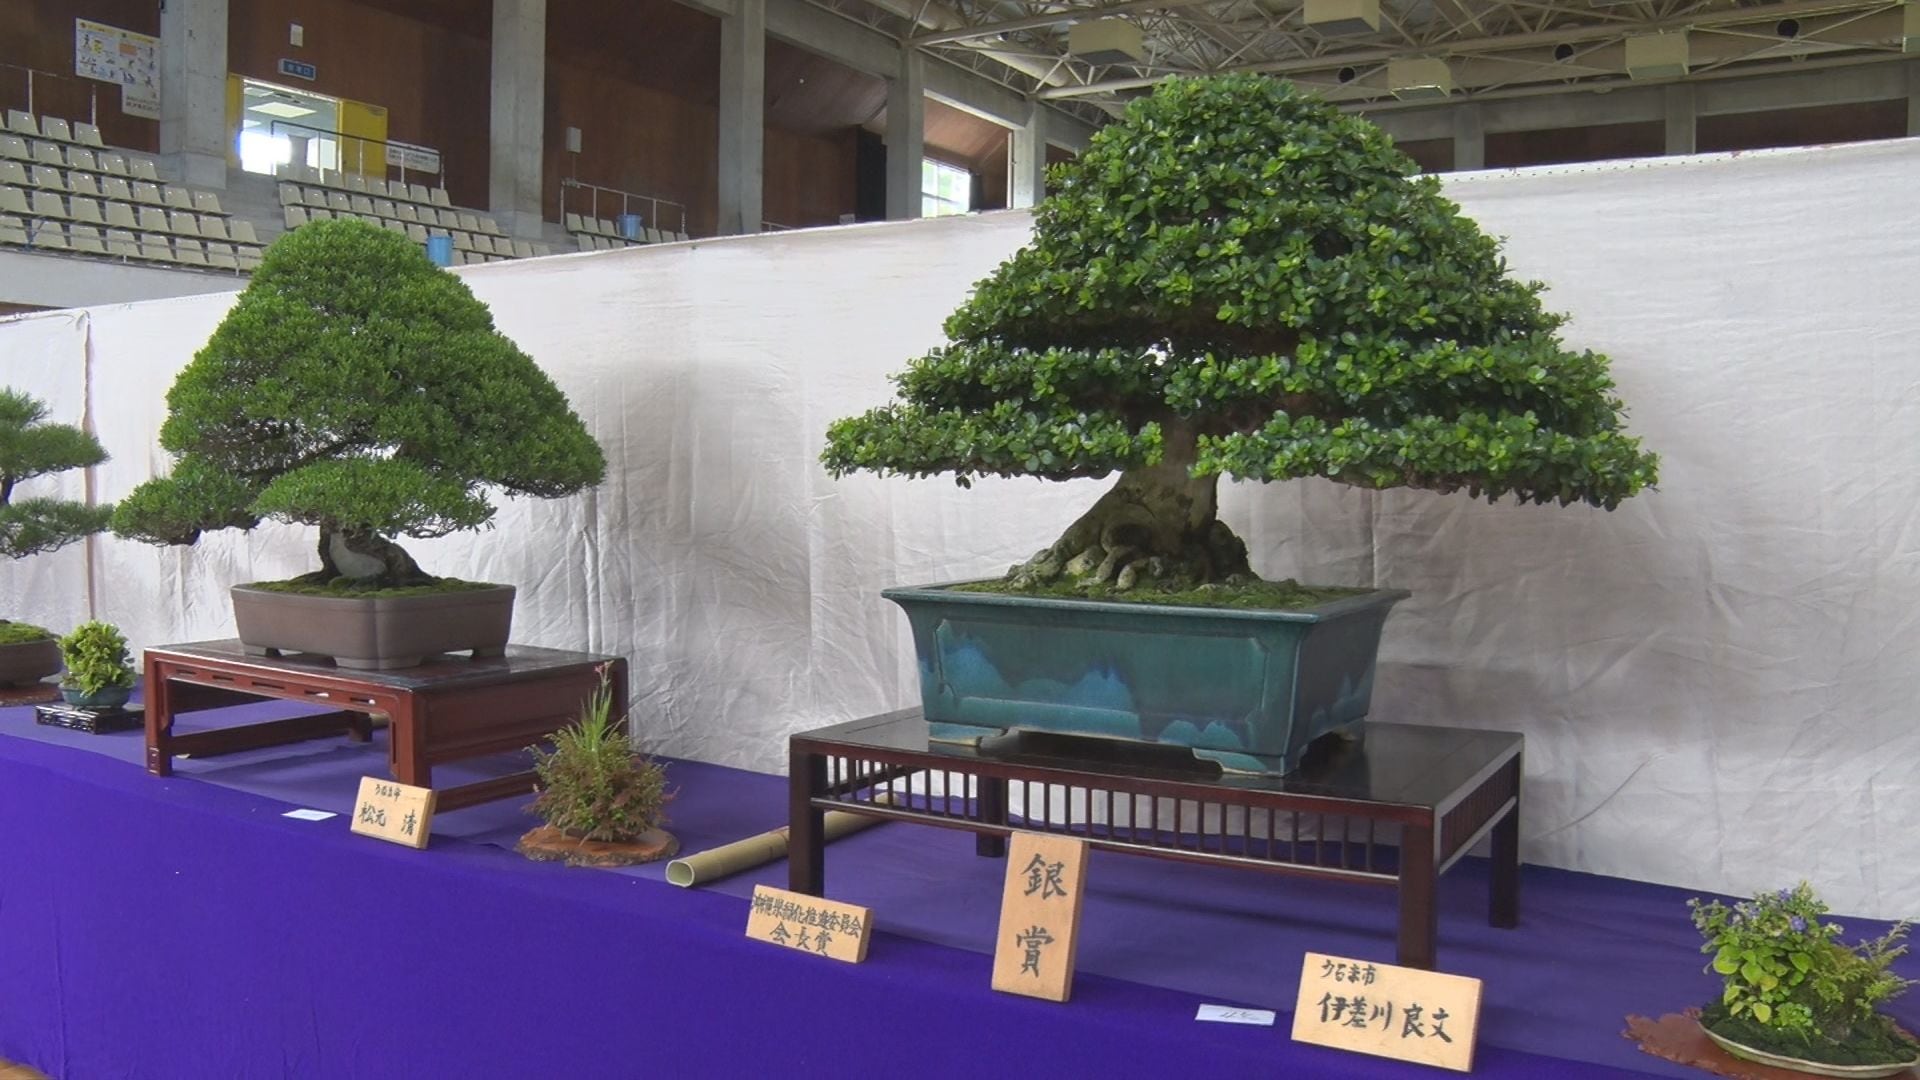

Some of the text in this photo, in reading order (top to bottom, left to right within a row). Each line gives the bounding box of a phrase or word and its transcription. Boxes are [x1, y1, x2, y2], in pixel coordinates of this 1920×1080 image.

[1016, 853, 1067, 978] 銀賞
[769, 920, 833, 957] 会長賞
[1320, 959, 1376, 986] うるま市
